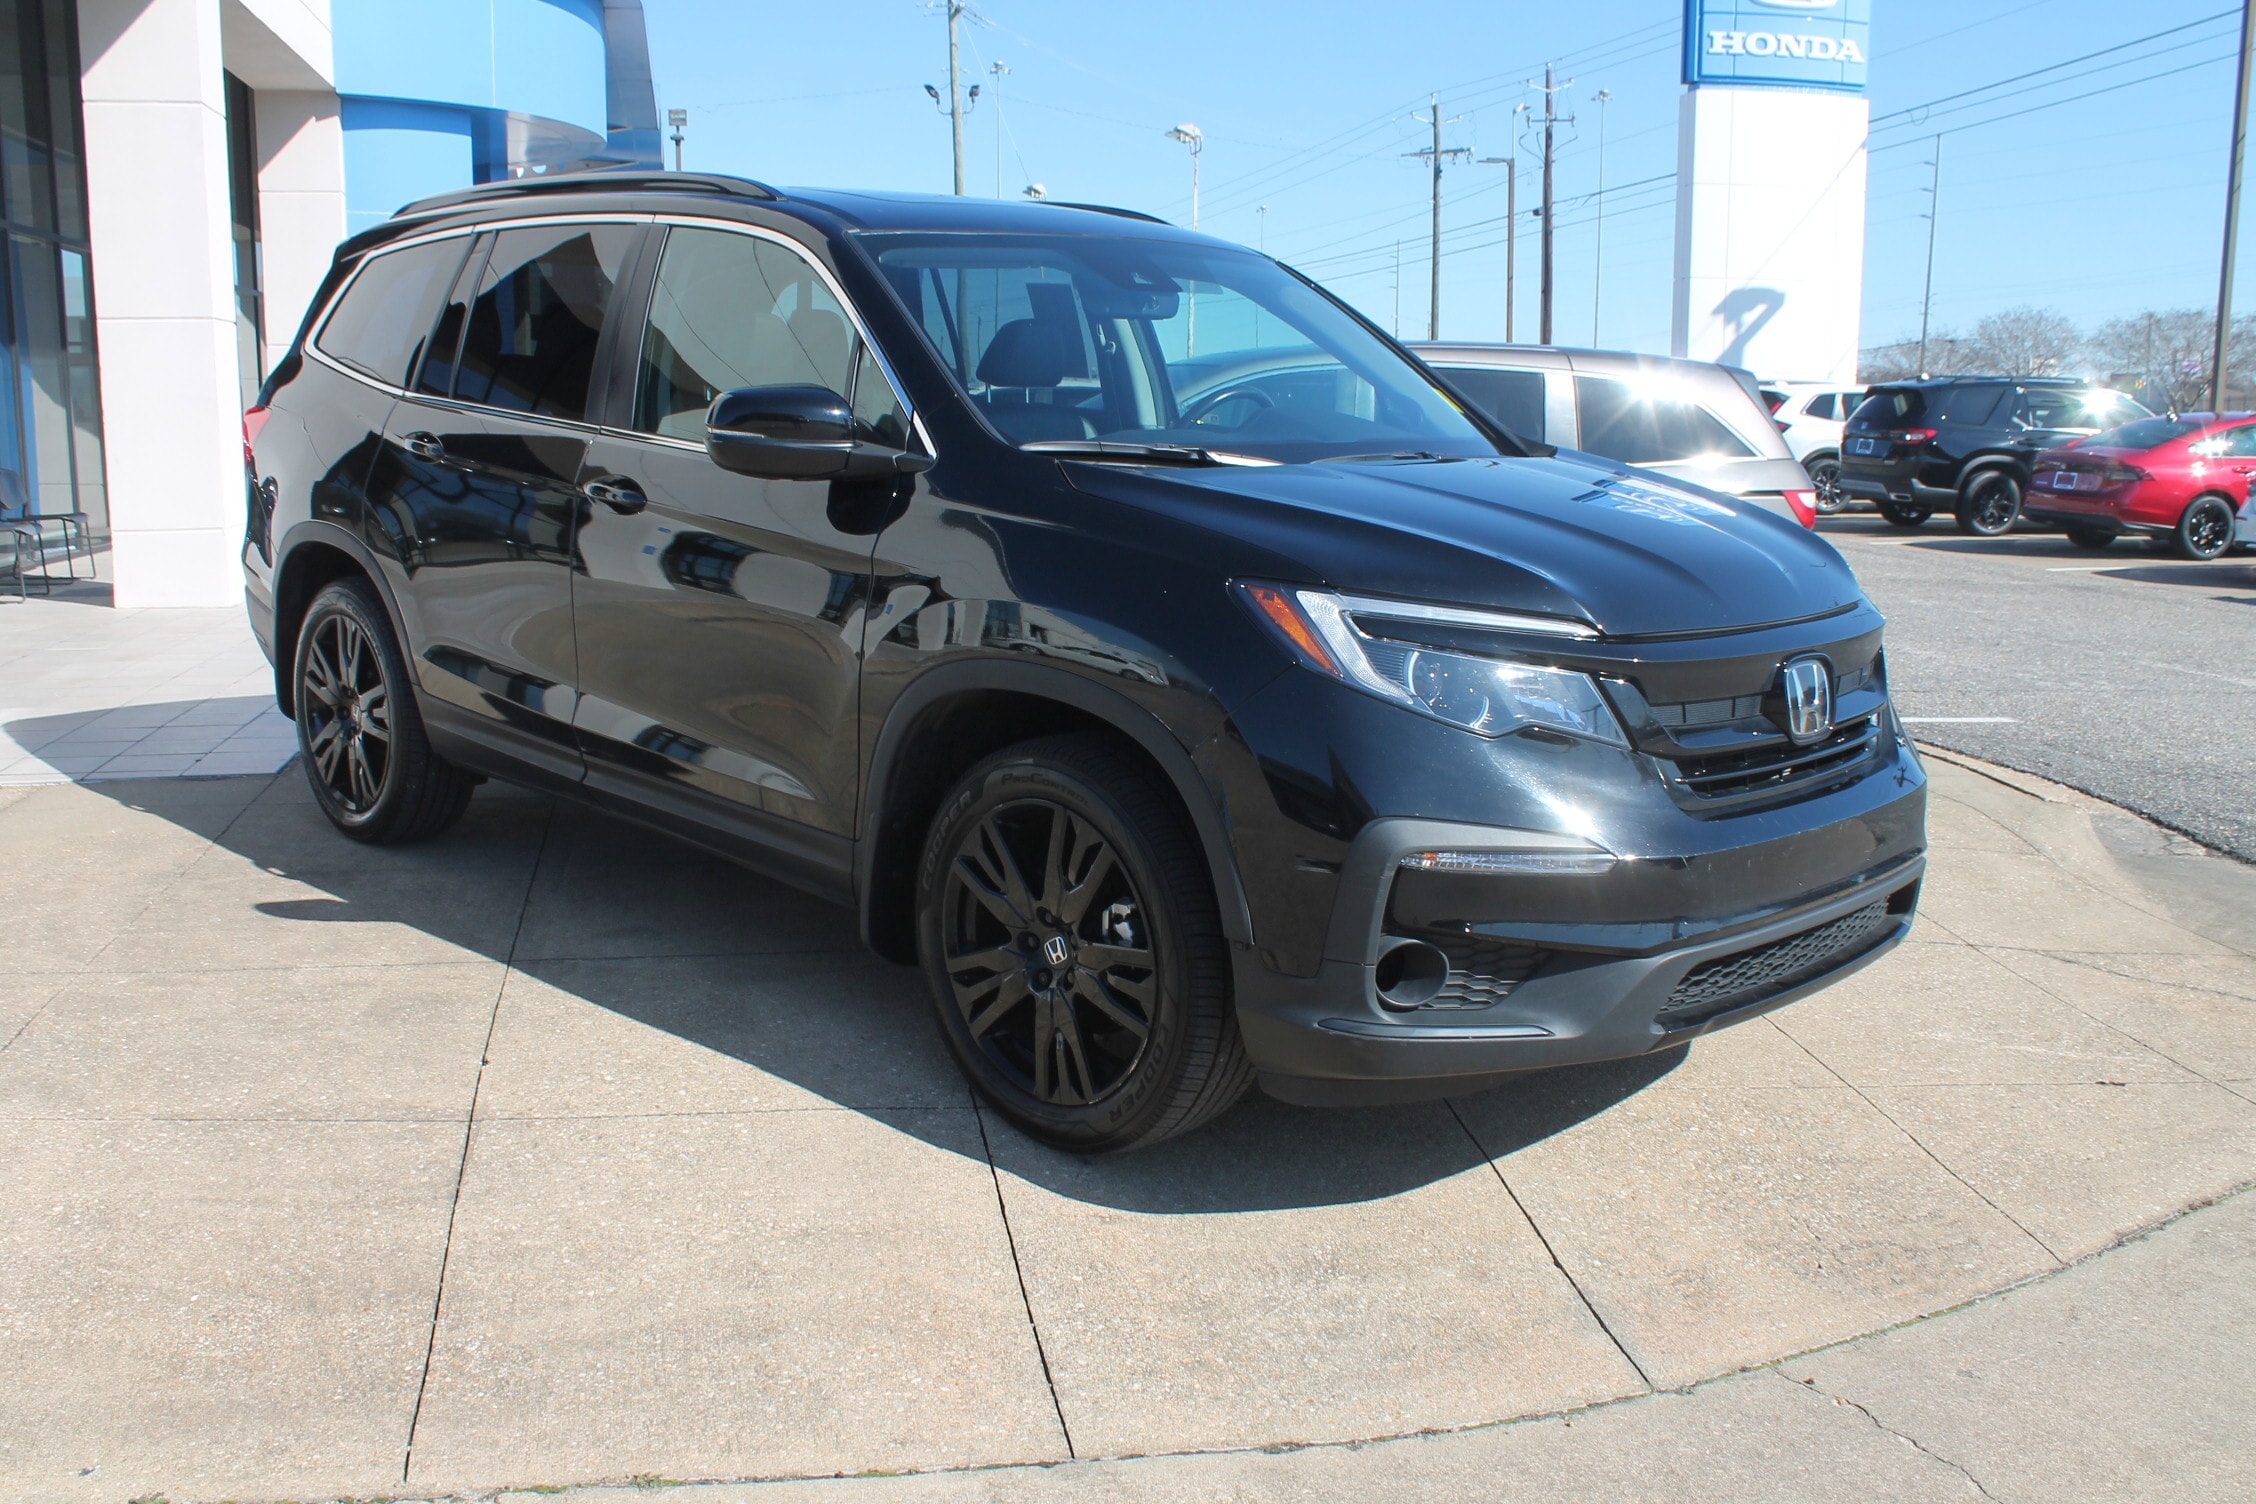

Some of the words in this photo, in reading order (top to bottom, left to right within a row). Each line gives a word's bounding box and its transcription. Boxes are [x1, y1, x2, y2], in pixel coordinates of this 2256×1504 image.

[1707, 31, 1864, 63] HONDA
[923, 790, 970, 890] COOPER
[1109, 1023, 1168, 1122] COOPER
